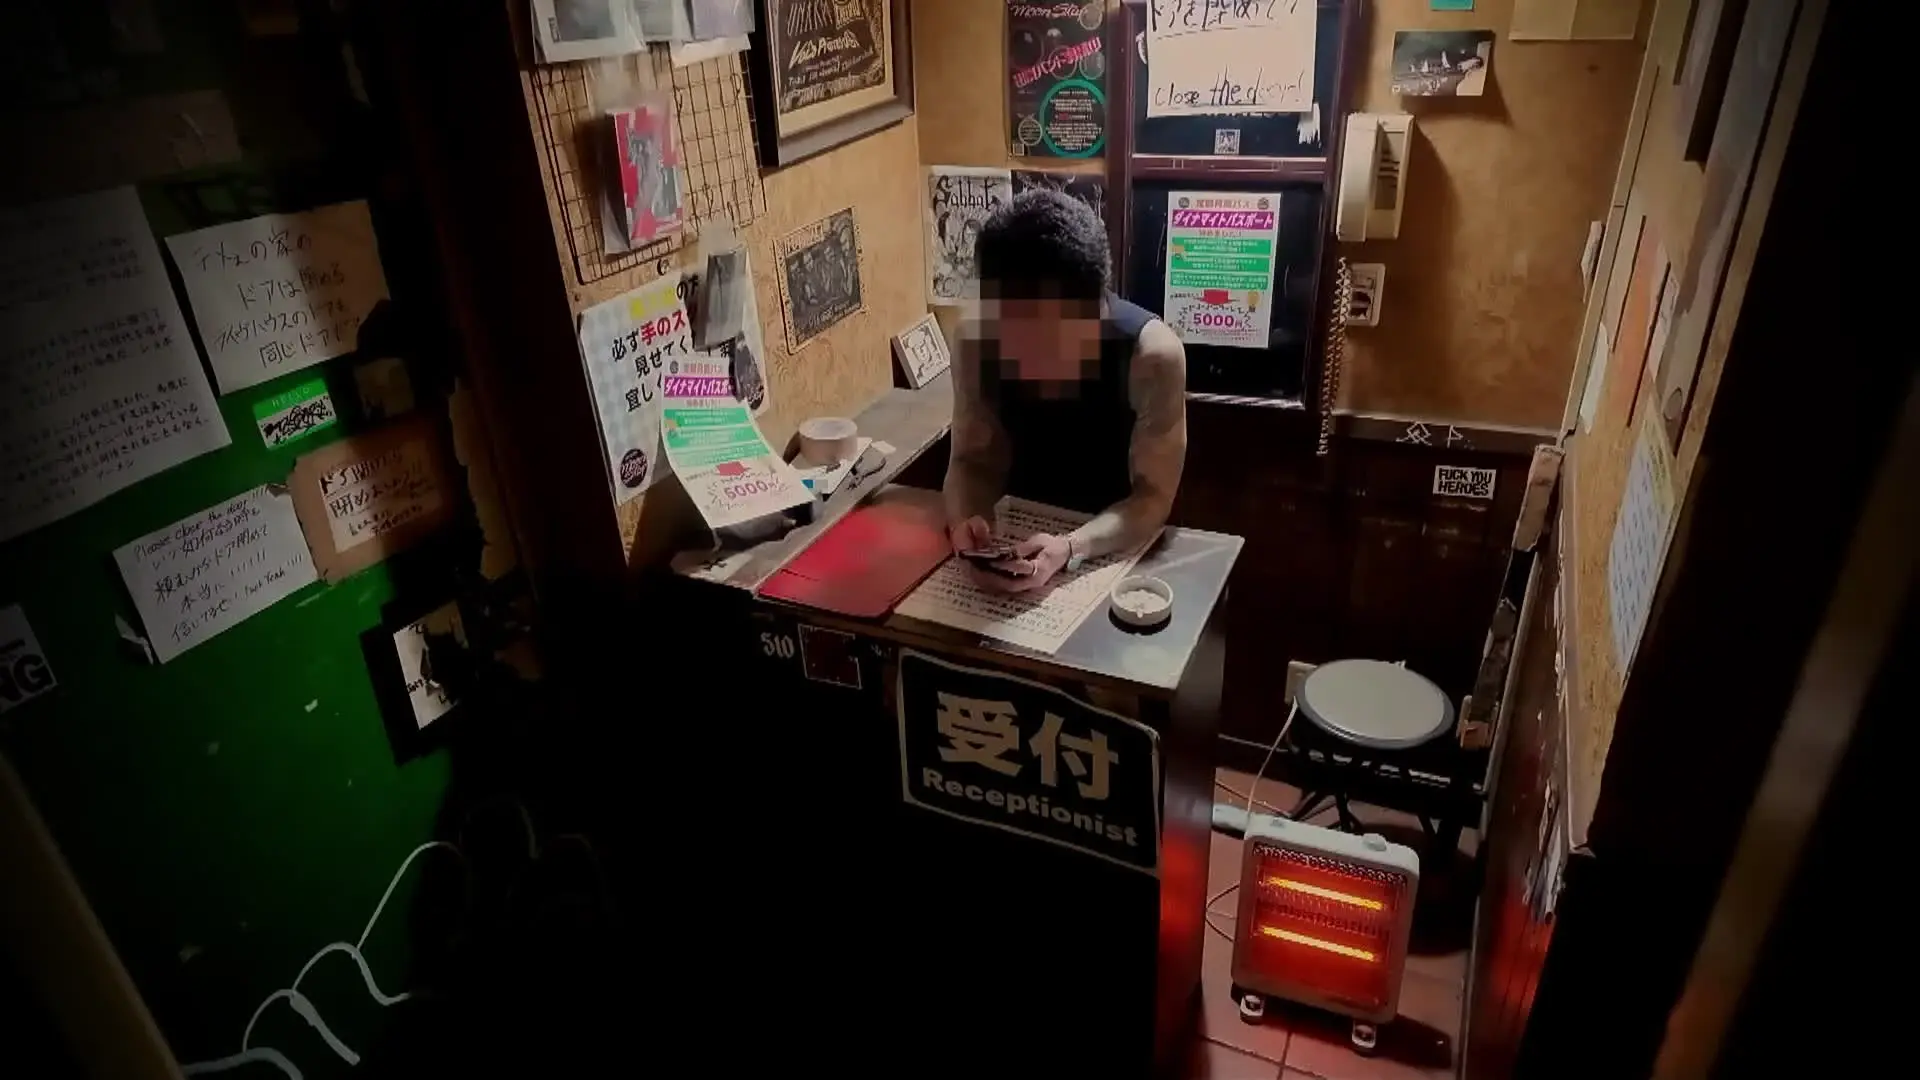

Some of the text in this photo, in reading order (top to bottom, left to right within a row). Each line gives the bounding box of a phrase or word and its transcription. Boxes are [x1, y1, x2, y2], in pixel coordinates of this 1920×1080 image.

[1210, 64, 1242, 106] the
[932, 175, 999, 212] Sabbat
[1437, 481, 1489, 496] HEROES
[1438, 468, 1493, 484] FUCK YOU
[936, 689, 1120, 800] 受付
[921, 766, 1140, 847] Receptionist
